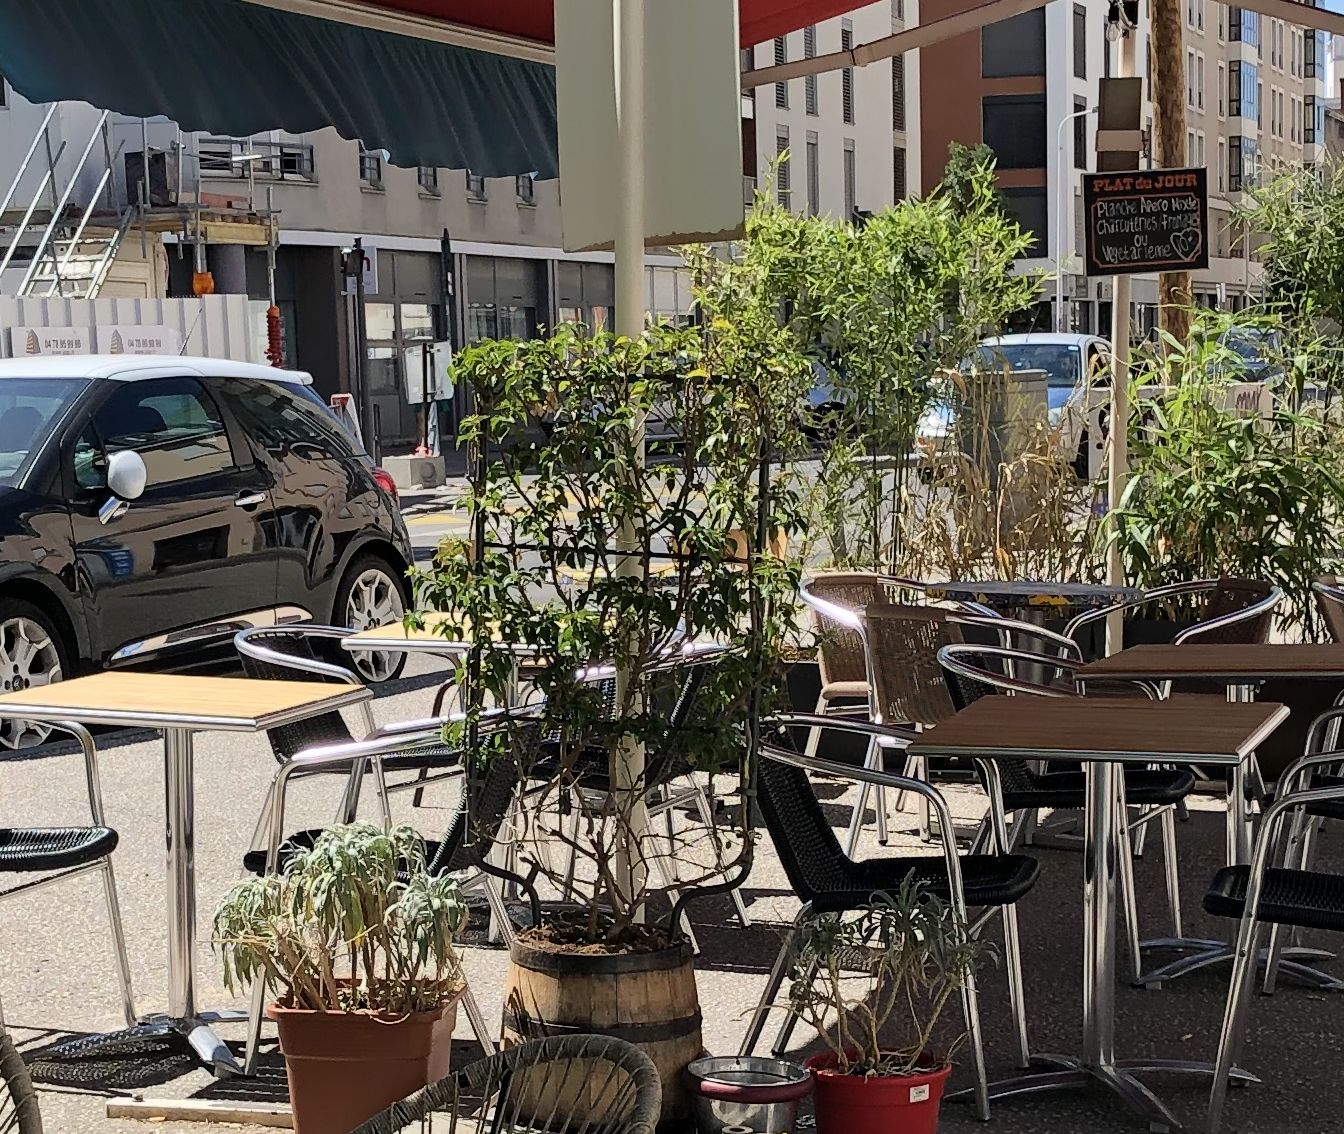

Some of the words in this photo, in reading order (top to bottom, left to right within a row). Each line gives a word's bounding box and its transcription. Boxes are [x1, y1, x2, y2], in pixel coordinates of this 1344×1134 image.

[1092, 177, 1134, 192] PLAT
[1135, 176, 1152, 190] du
[1155, 173, 1198, 188] JOUR
